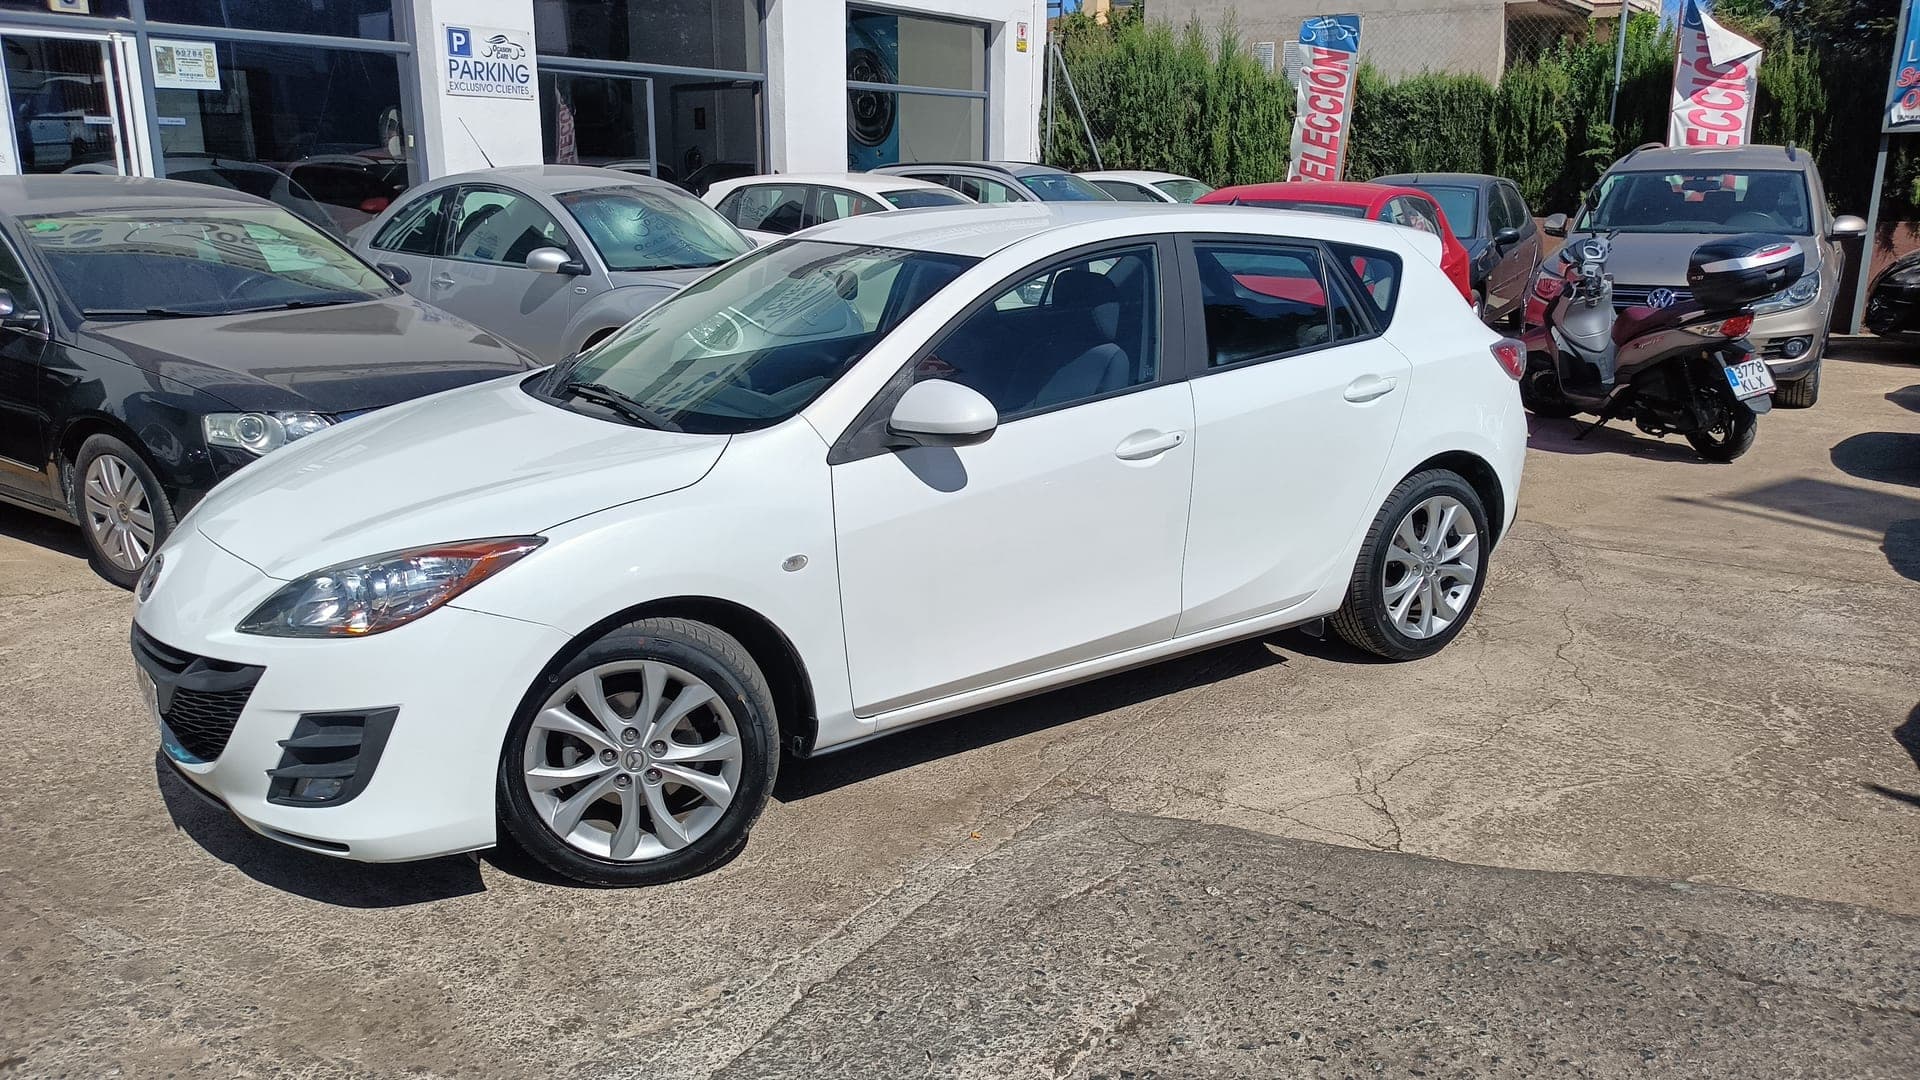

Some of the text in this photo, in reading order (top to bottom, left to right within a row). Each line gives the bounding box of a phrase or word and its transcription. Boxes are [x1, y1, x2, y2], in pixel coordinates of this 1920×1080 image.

[452, 32, 465, 52] P
[448, 59, 530, 83] PARKING
[449, 81, 530, 95] EXCLUSIVO CLIENTES
[1290, 47, 1350, 182] ELECCIÓN
[1735, 361, 1764, 378] 3778
[1740, 376, 1766, 392] KLX
